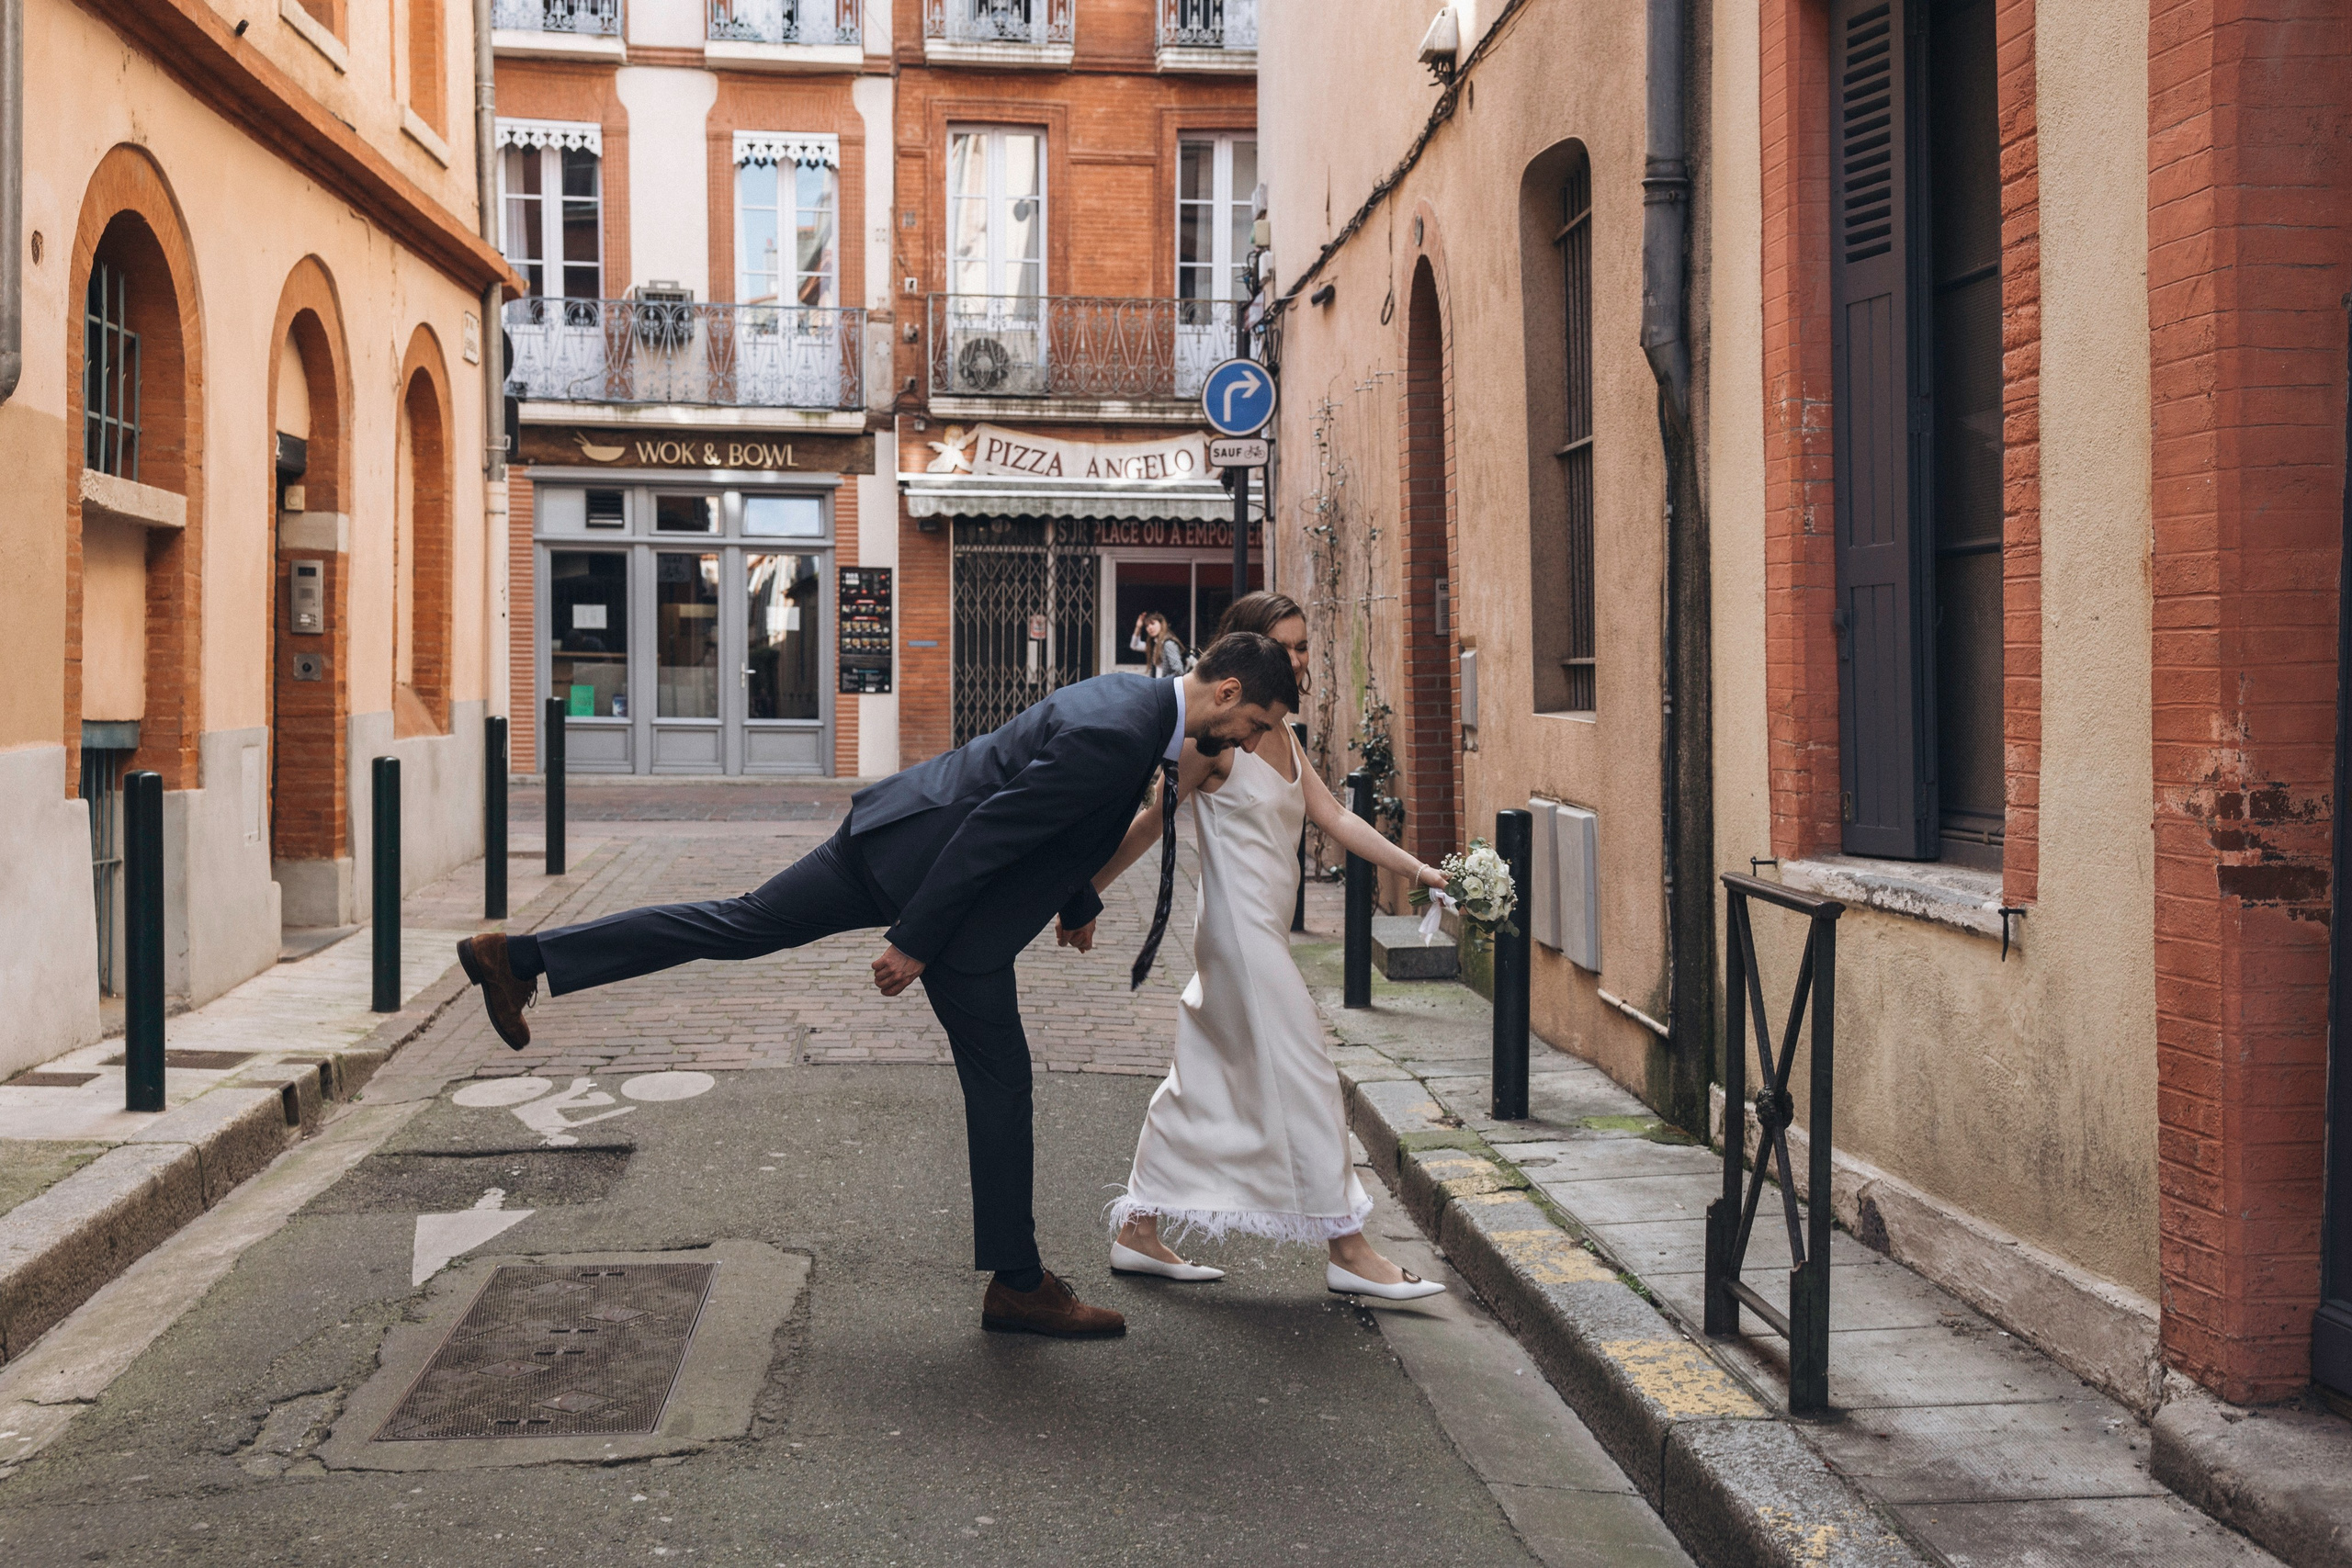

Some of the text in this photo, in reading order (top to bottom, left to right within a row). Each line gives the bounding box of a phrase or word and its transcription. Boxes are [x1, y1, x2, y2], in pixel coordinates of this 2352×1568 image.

[635, 441, 799, 467] WOK & BOWL
[985, 437, 1194, 479] PIZZA ANGELO
[1213, 447, 1242, 457] SAUF
[1093, 520, 1139, 544] PLACE
[1143, 521, 1164, 544] OU
[1186, 522, 1263, 546] EMPORER
